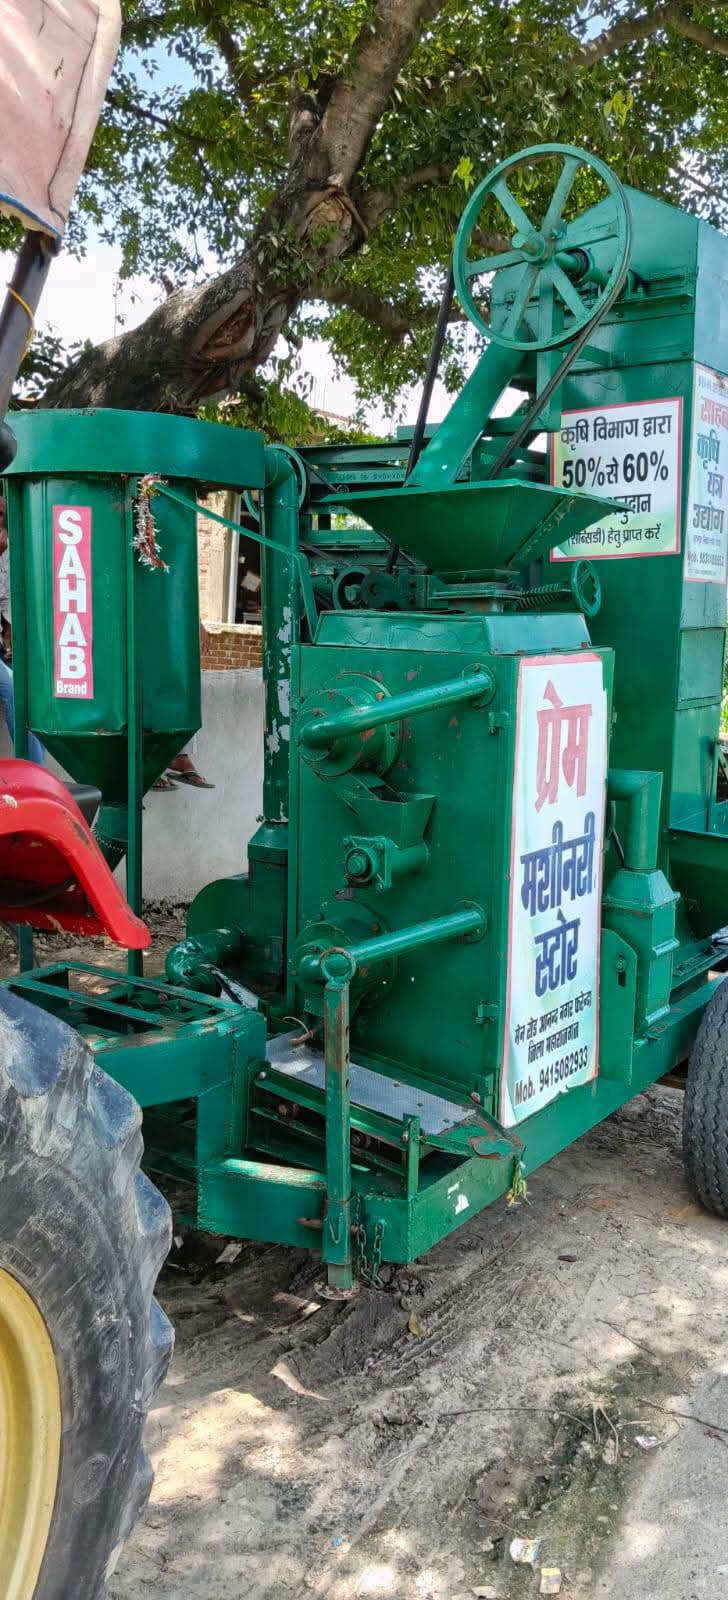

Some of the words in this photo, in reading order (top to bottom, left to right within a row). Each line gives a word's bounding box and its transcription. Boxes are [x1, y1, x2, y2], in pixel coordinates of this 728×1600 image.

[560, 418, 589, 451] कृषि
[593, 416, 639, 442] विभाग
[643, 415, 672, 437] द्वारा
[696, 429, 720, 470] कृषि
[622, 450, 669, 483] 60%
[607, 527, 621, 548] हेतु
[623, 528, 642, 544] प्राप्त
[644, 523, 662, 541] करें
[692, 500, 725, 534] उद्योग
[58, 509, 88, 679] SAHAB
[56, 680, 87, 695] Brand
[534, 679, 593, 813] प्रेम
[520, 811, 596, 917] मशीनरी
[534, 907, 581, 998] स्टोर
[514, 1076, 536, 1106] Mob.
[539, 1045, 588, 1092] 9415082933
